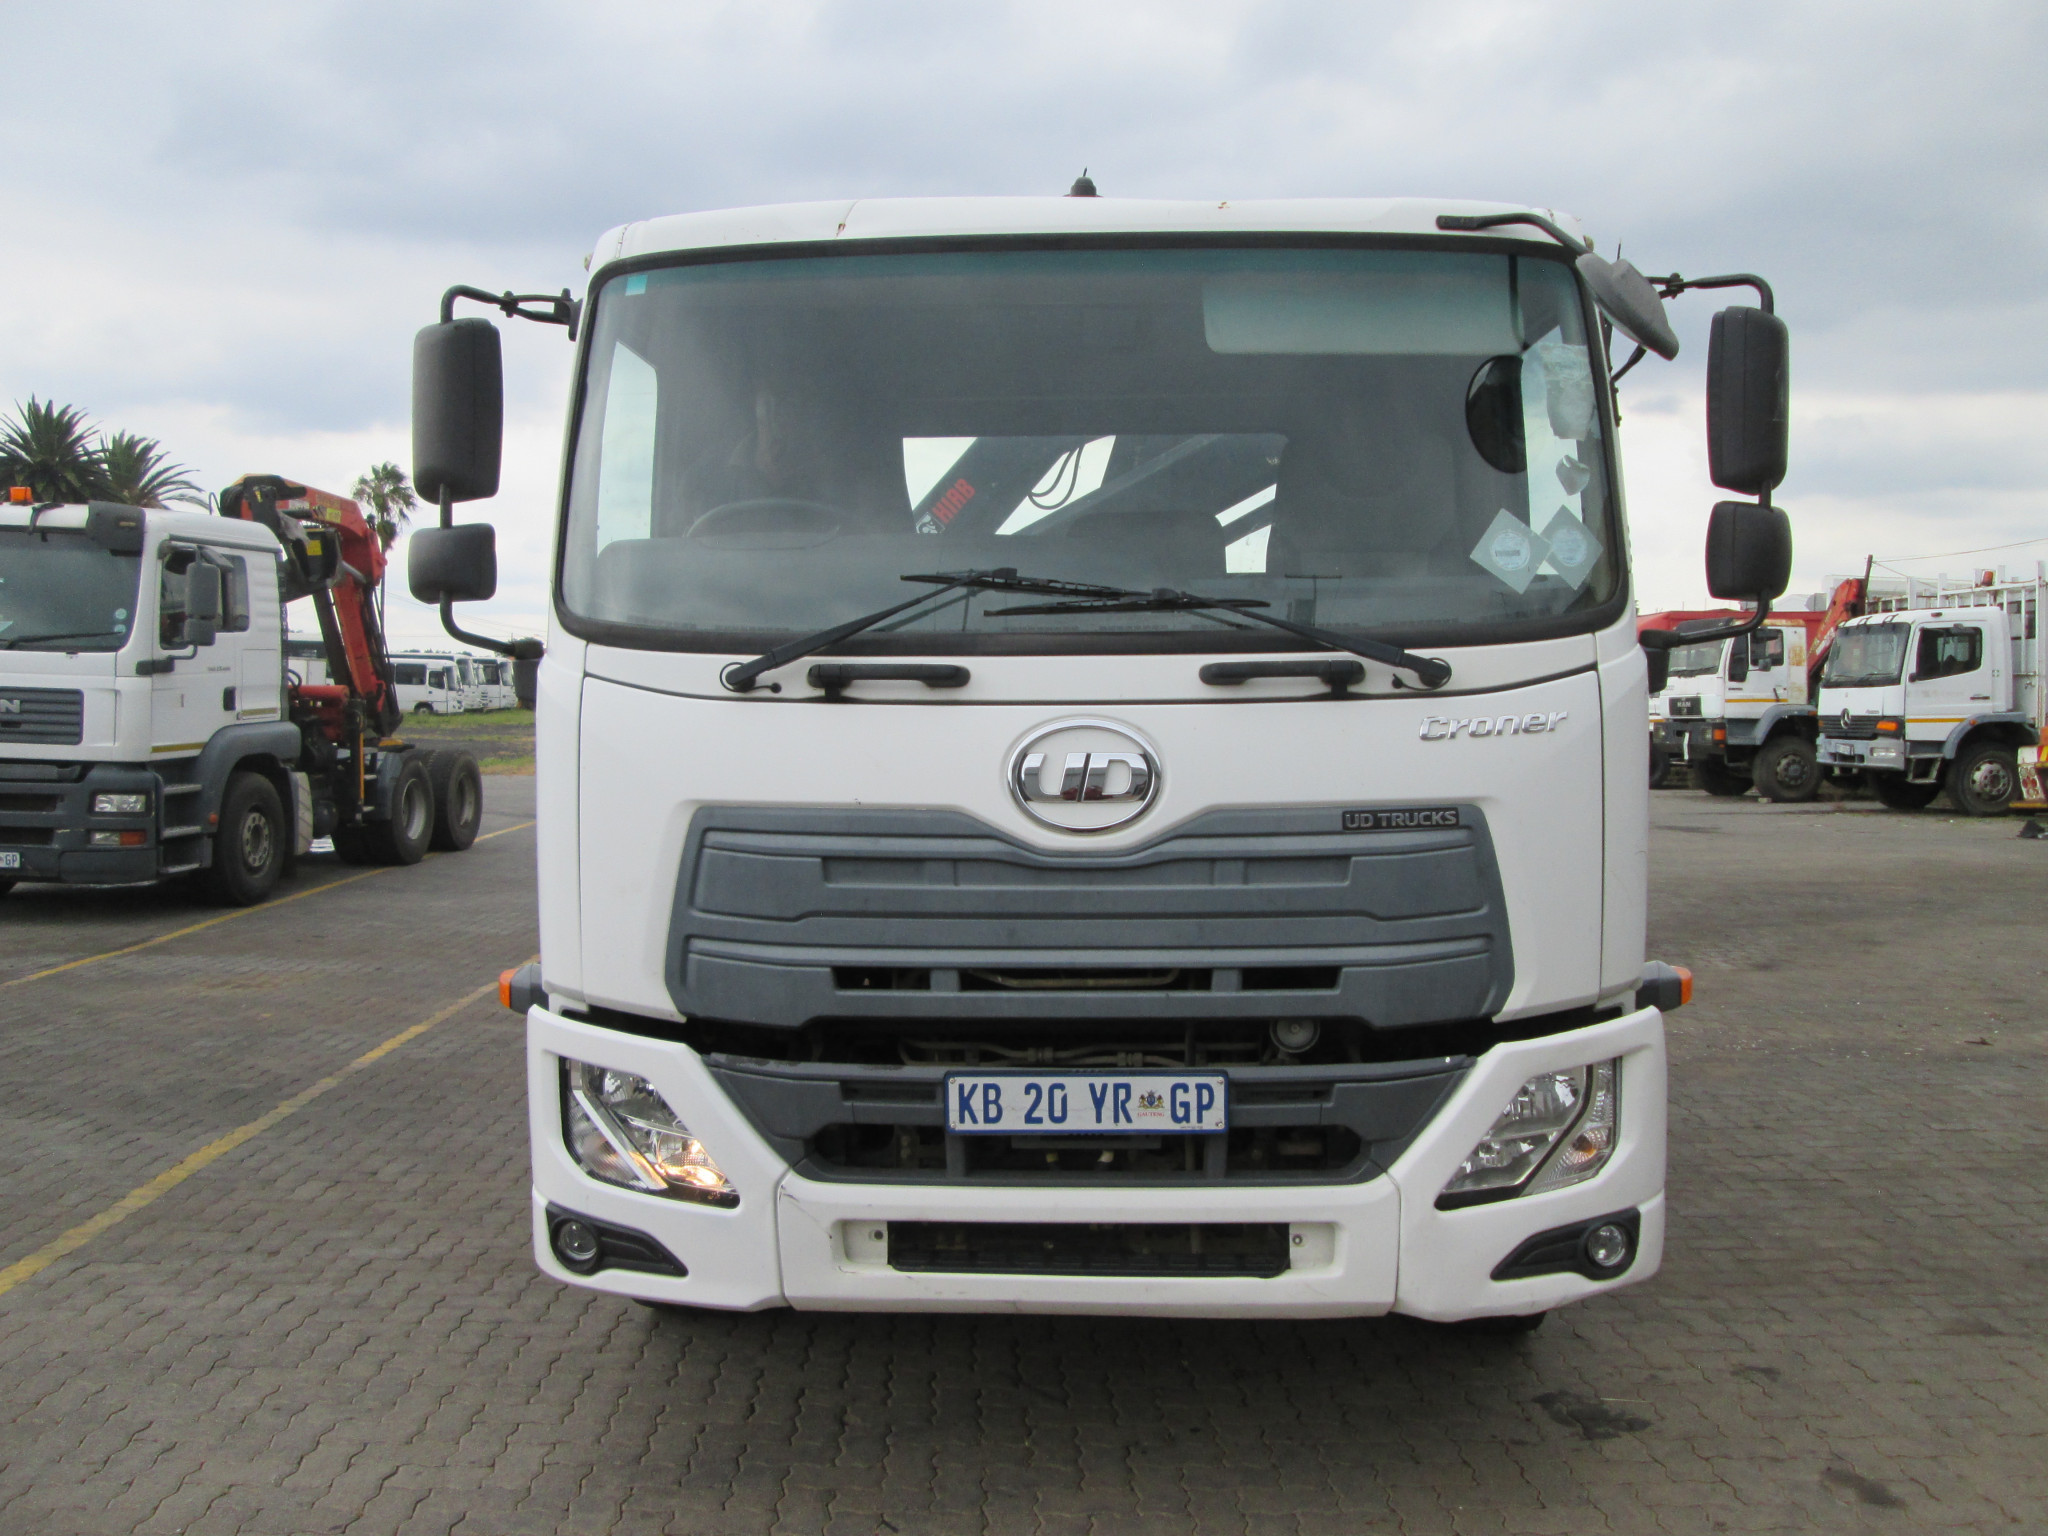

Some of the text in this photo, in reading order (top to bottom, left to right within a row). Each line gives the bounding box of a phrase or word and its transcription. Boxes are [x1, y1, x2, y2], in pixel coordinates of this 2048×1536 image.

[931, 478, 976, 524] HIAB
[1419, 711, 1568, 741] Croner
[1021, 752, 1149, 801] UD
[1345, 810, 1458, 829] UD TRUCKS
[957, 1082, 1215, 1125] KB 20 YR GP
